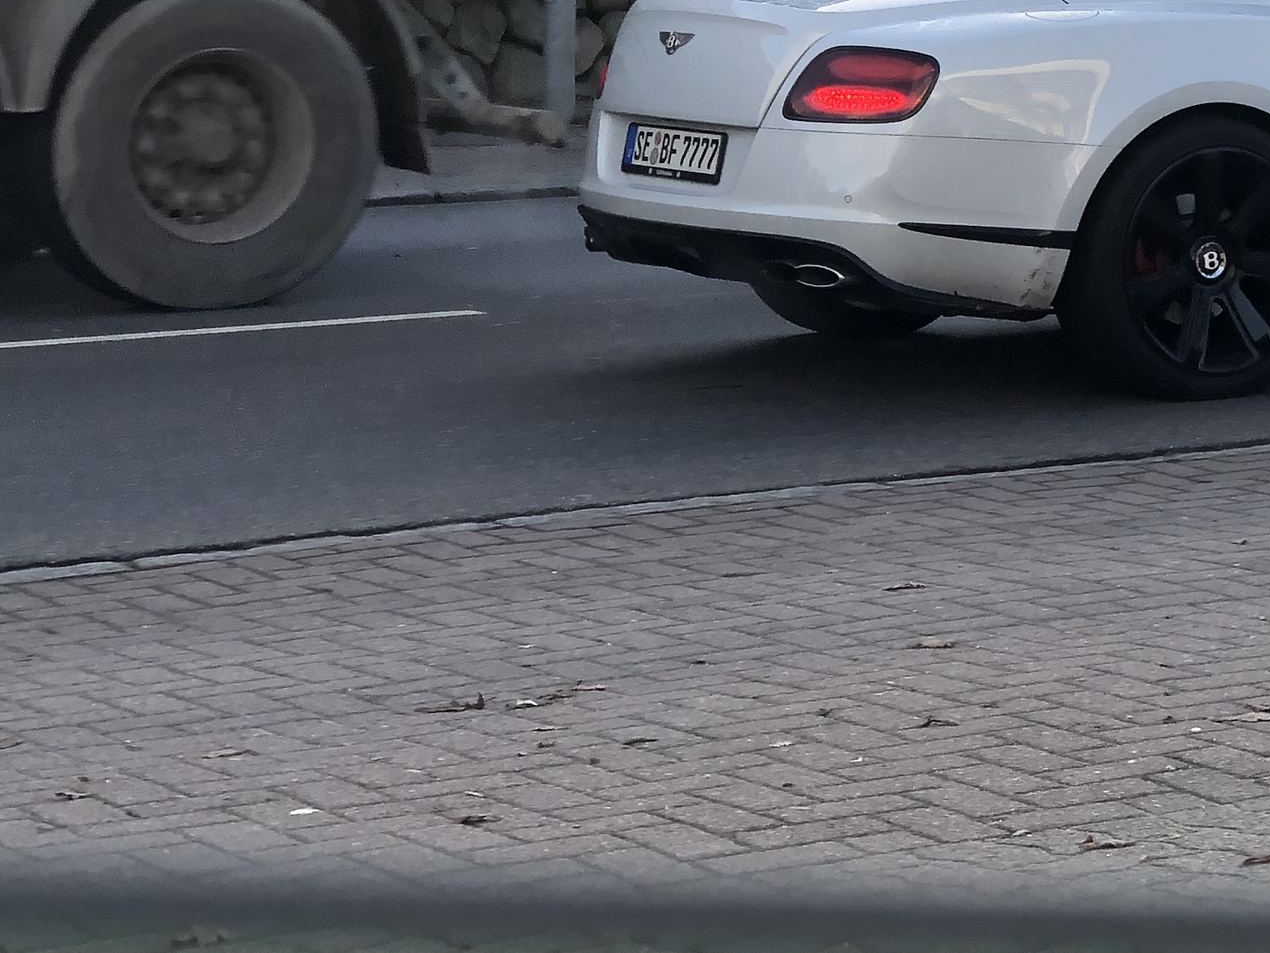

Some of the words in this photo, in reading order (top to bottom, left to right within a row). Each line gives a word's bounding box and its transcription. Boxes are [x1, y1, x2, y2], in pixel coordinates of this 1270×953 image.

[634, 131, 653, 161] SE
[659, 133, 680, 164] BF
[680, 136, 719, 170] 7777
[1203, 251, 1219, 270] B
